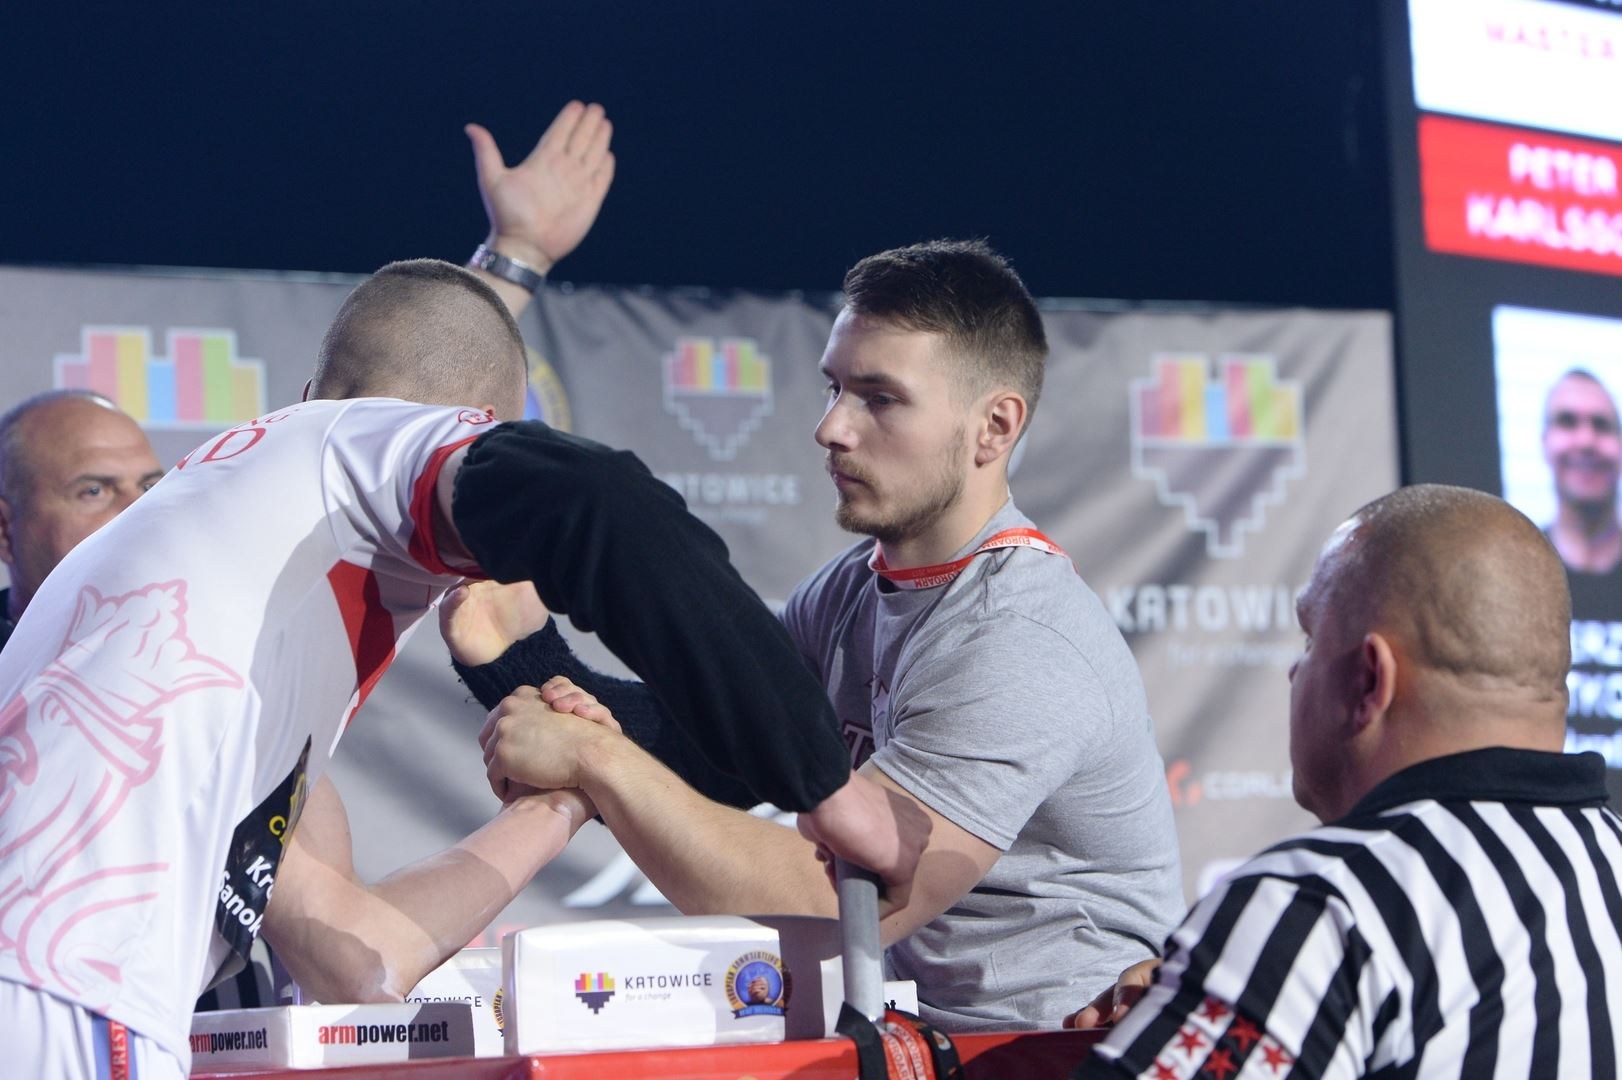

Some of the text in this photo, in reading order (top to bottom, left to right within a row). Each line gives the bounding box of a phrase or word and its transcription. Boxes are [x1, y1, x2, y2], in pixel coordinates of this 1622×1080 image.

[1508, 143, 1618, 197] PETER
[652, 472, 800, 504] ATOWICE
[1109, 584, 1304, 632] KATOWI
[219, 869, 264, 938] Sanok
[624, 973, 712, 989] KATOWICE
[188, 1027, 268, 1054] armpower.net
[318, 1020, 449, 1046] armpower.net
